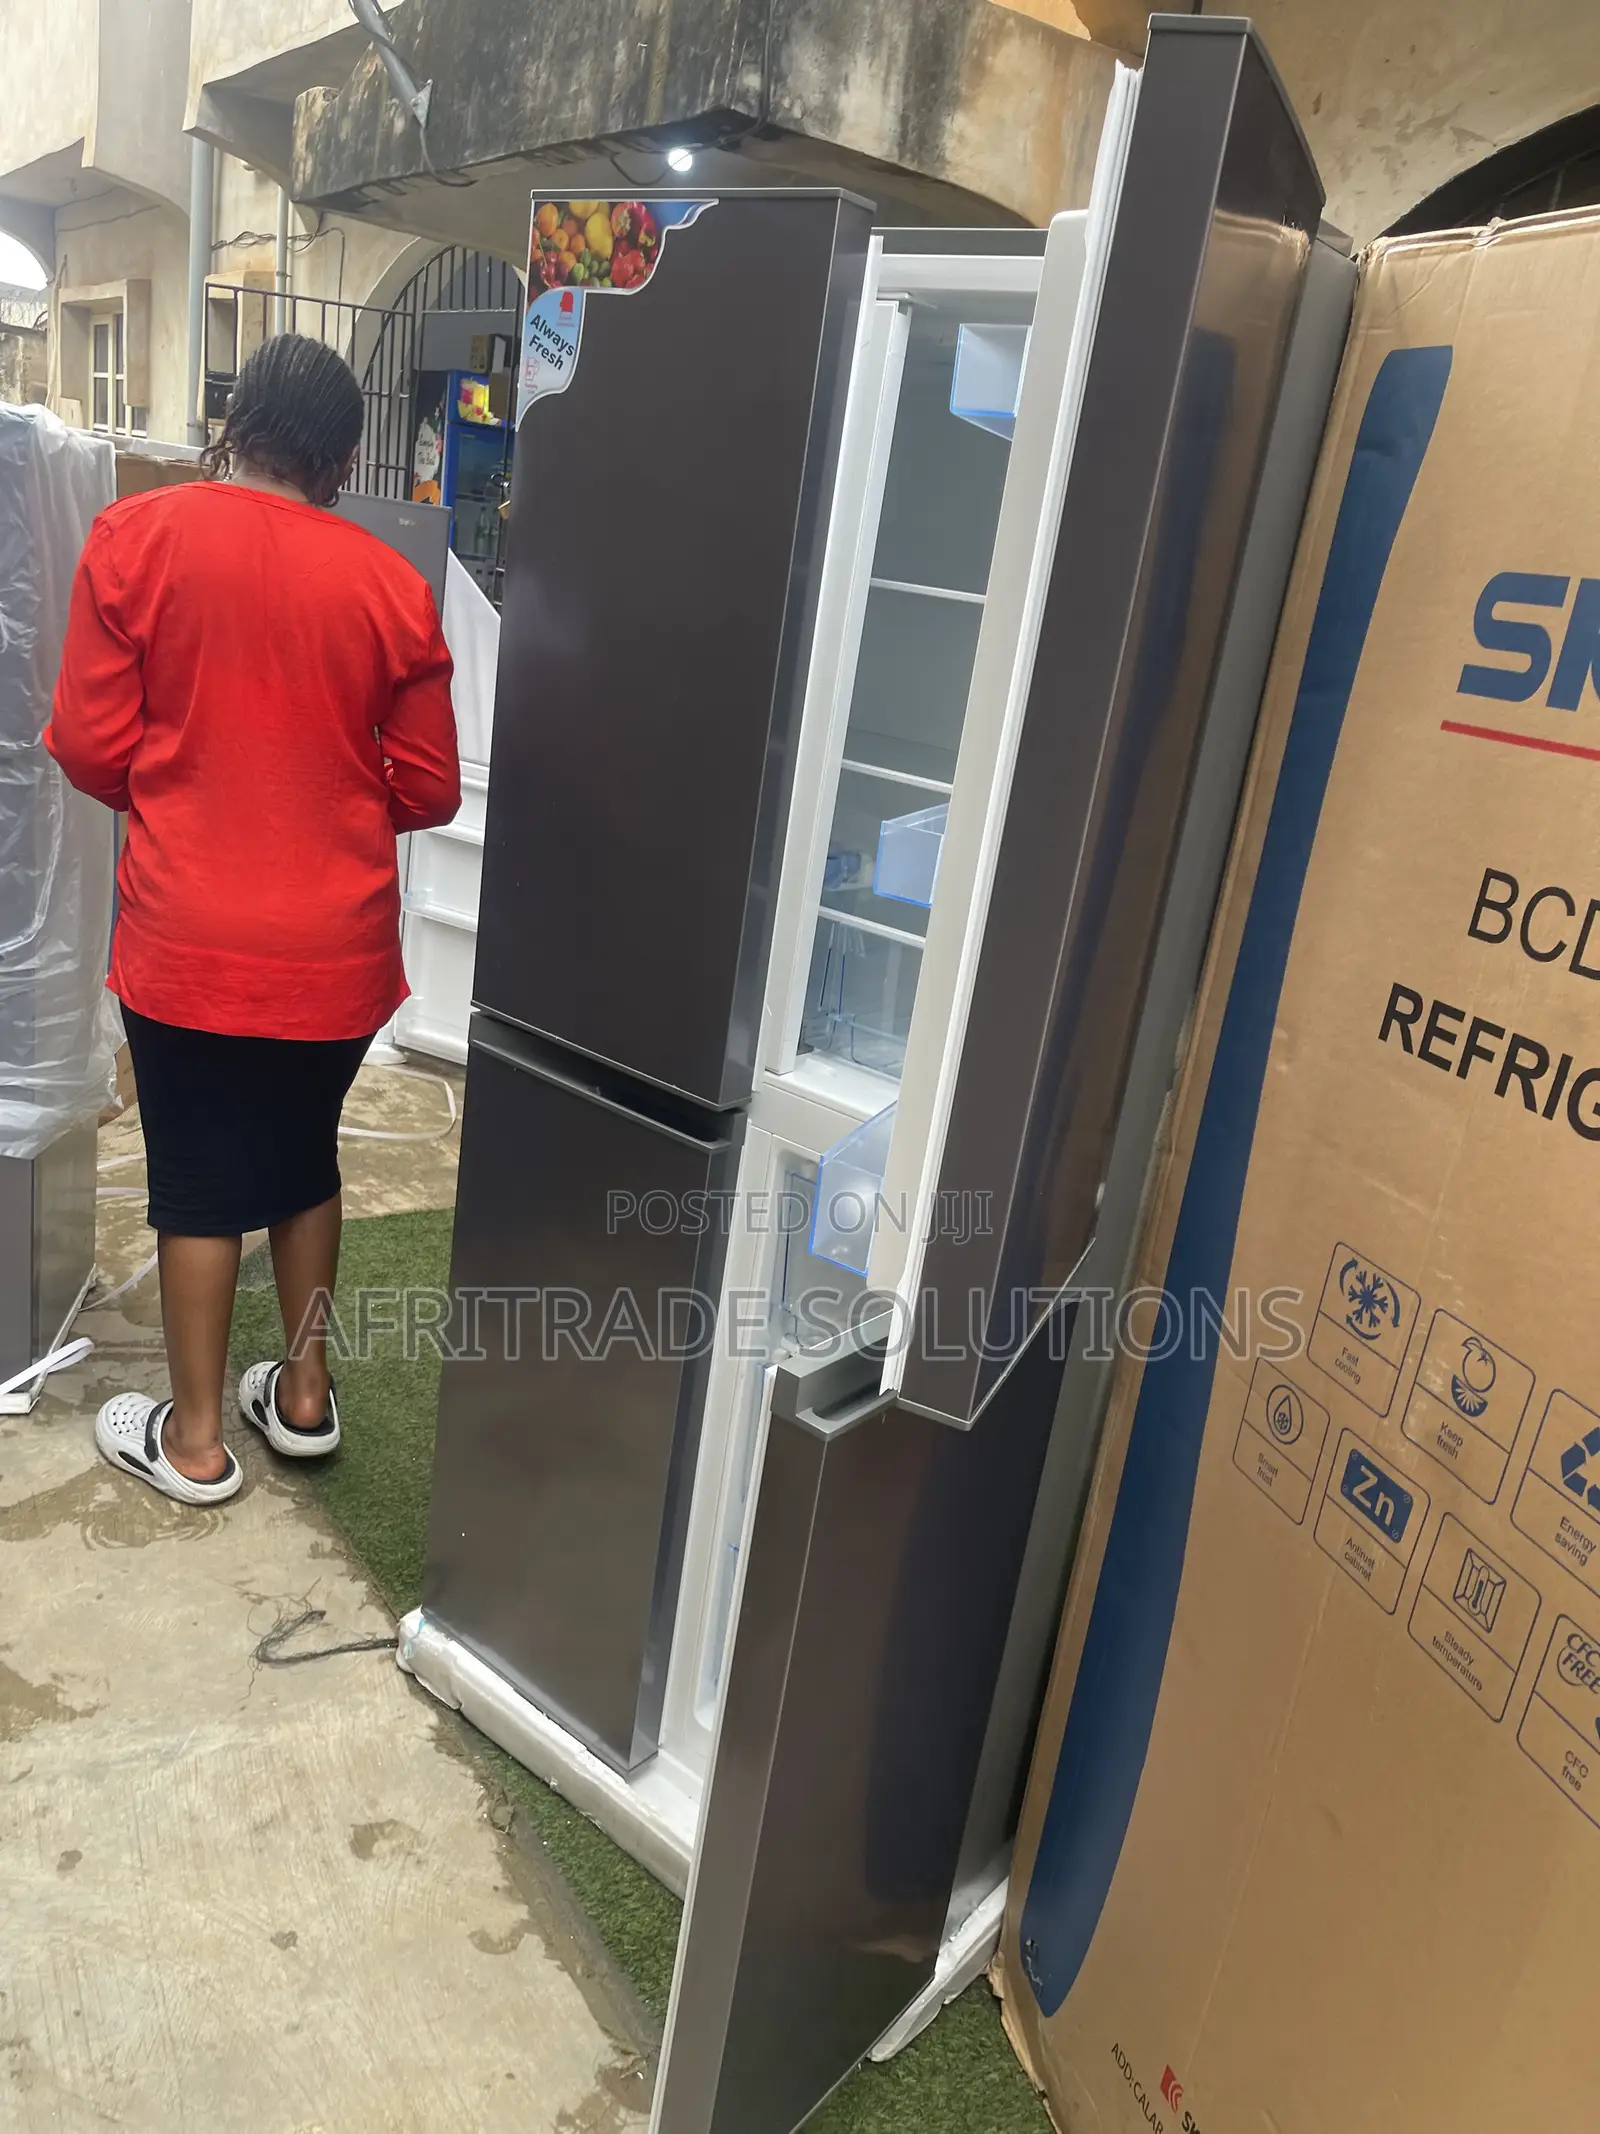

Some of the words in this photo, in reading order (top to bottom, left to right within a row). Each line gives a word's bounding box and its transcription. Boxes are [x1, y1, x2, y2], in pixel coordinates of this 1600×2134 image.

[529, 334, 564, 371] Fresh
[530, 314, 575, 357] Always
[1467, 867, 1600, 980] BCD
[1377, 981, 1600, 1142] REFRIG
[1334, 1358, 1361, 1384] cooling
[1341, 1346, 1359, 1366] Fast
[1436, 1435, 1459, 1460] fresh
[1440, 1421, 1463, 1447] Keep
[1256, 1466, 1273, 1487] frost
[1257, 1452, 1279, 1478] Smart
[1352, 1465, 1395, 1527] Zn
[1554, 1532, 1588, 1567] saving
[1559, 1516, 1597, 1553] Energy
[1344, 1551, 1372, 1582] cabinet
[1345, 1538, 1376, 1570] Antirust
[1432, 1635, 1483, 1692] temperature
[1444, 1631, 1475, 1666] Steady
[1567, 1633, 1600, 1668] CFC
[1562, 1652, 1600, 1695] FREE
[1561, 1765, 1582, 1792] free
[1565, 1750, 1589, 1778] CFC
